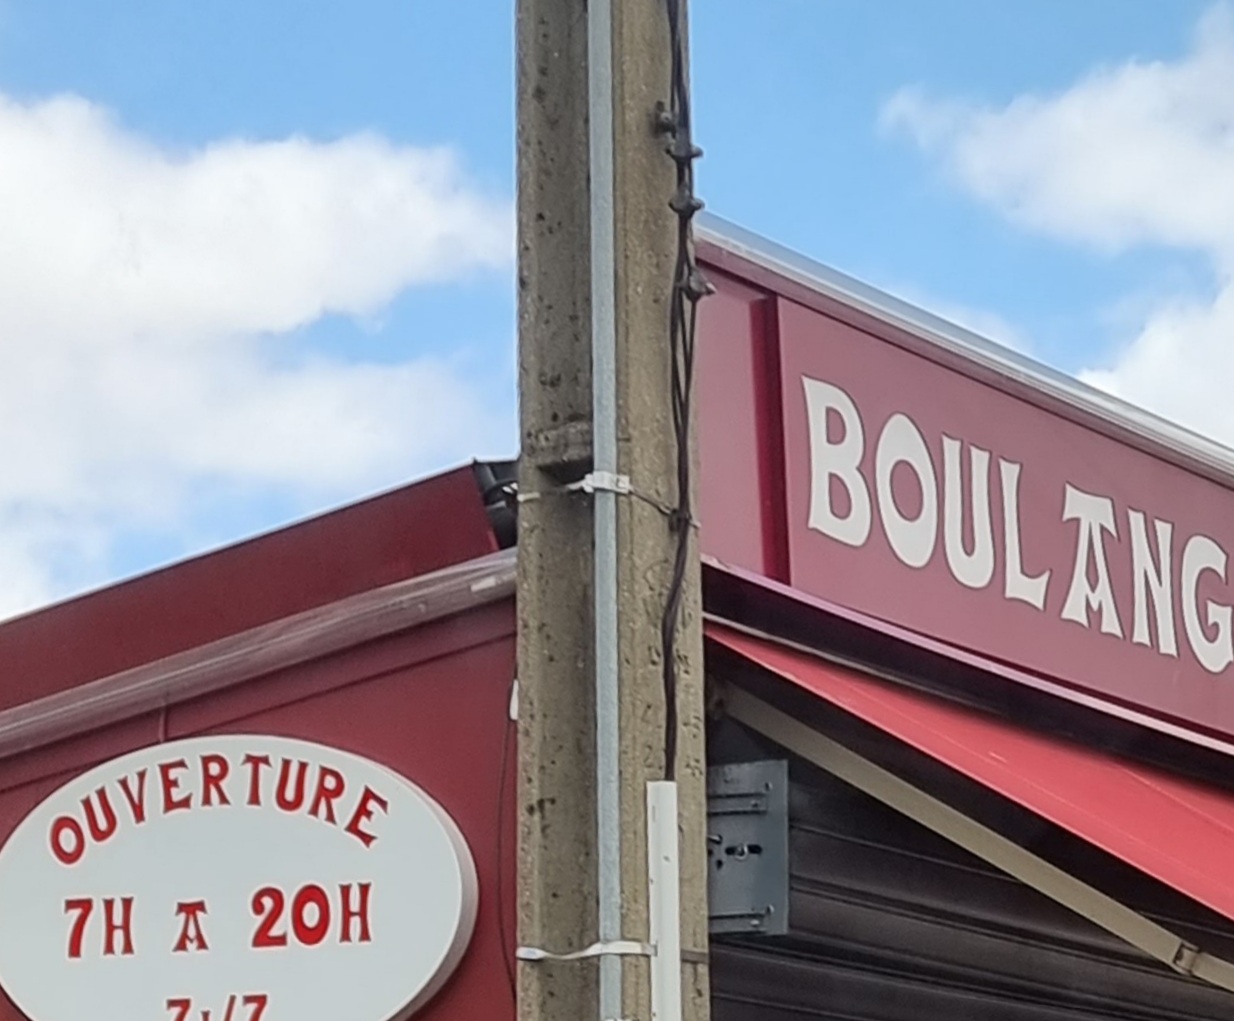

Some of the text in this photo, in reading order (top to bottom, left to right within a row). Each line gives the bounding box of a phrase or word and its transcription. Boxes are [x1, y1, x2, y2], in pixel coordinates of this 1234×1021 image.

[49, 752, 389, 865] OUVERTURE
[64, 881, 373, 959] 7H A 20H
